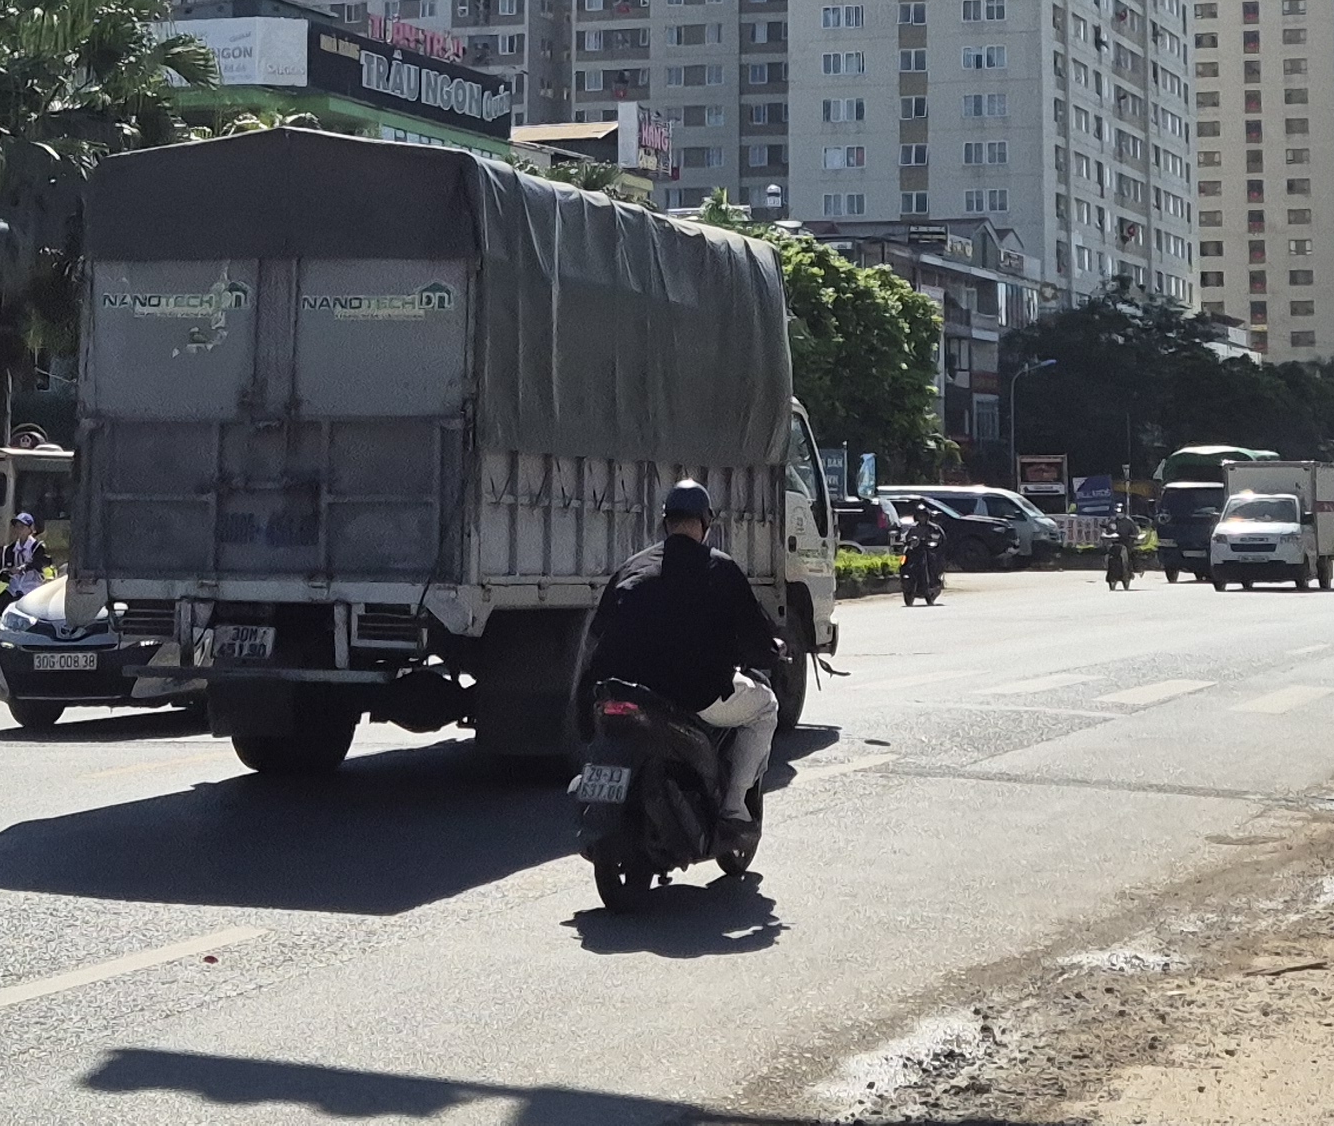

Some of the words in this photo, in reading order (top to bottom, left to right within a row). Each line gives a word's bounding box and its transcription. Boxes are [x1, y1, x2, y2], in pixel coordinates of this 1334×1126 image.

[360, 48, 420, 102] TRÂU
[421, 68, 483, 119] NGON
[103, 293, 215, 308] NANOTECH
[302, 296, 417, 310] NANOTECH
